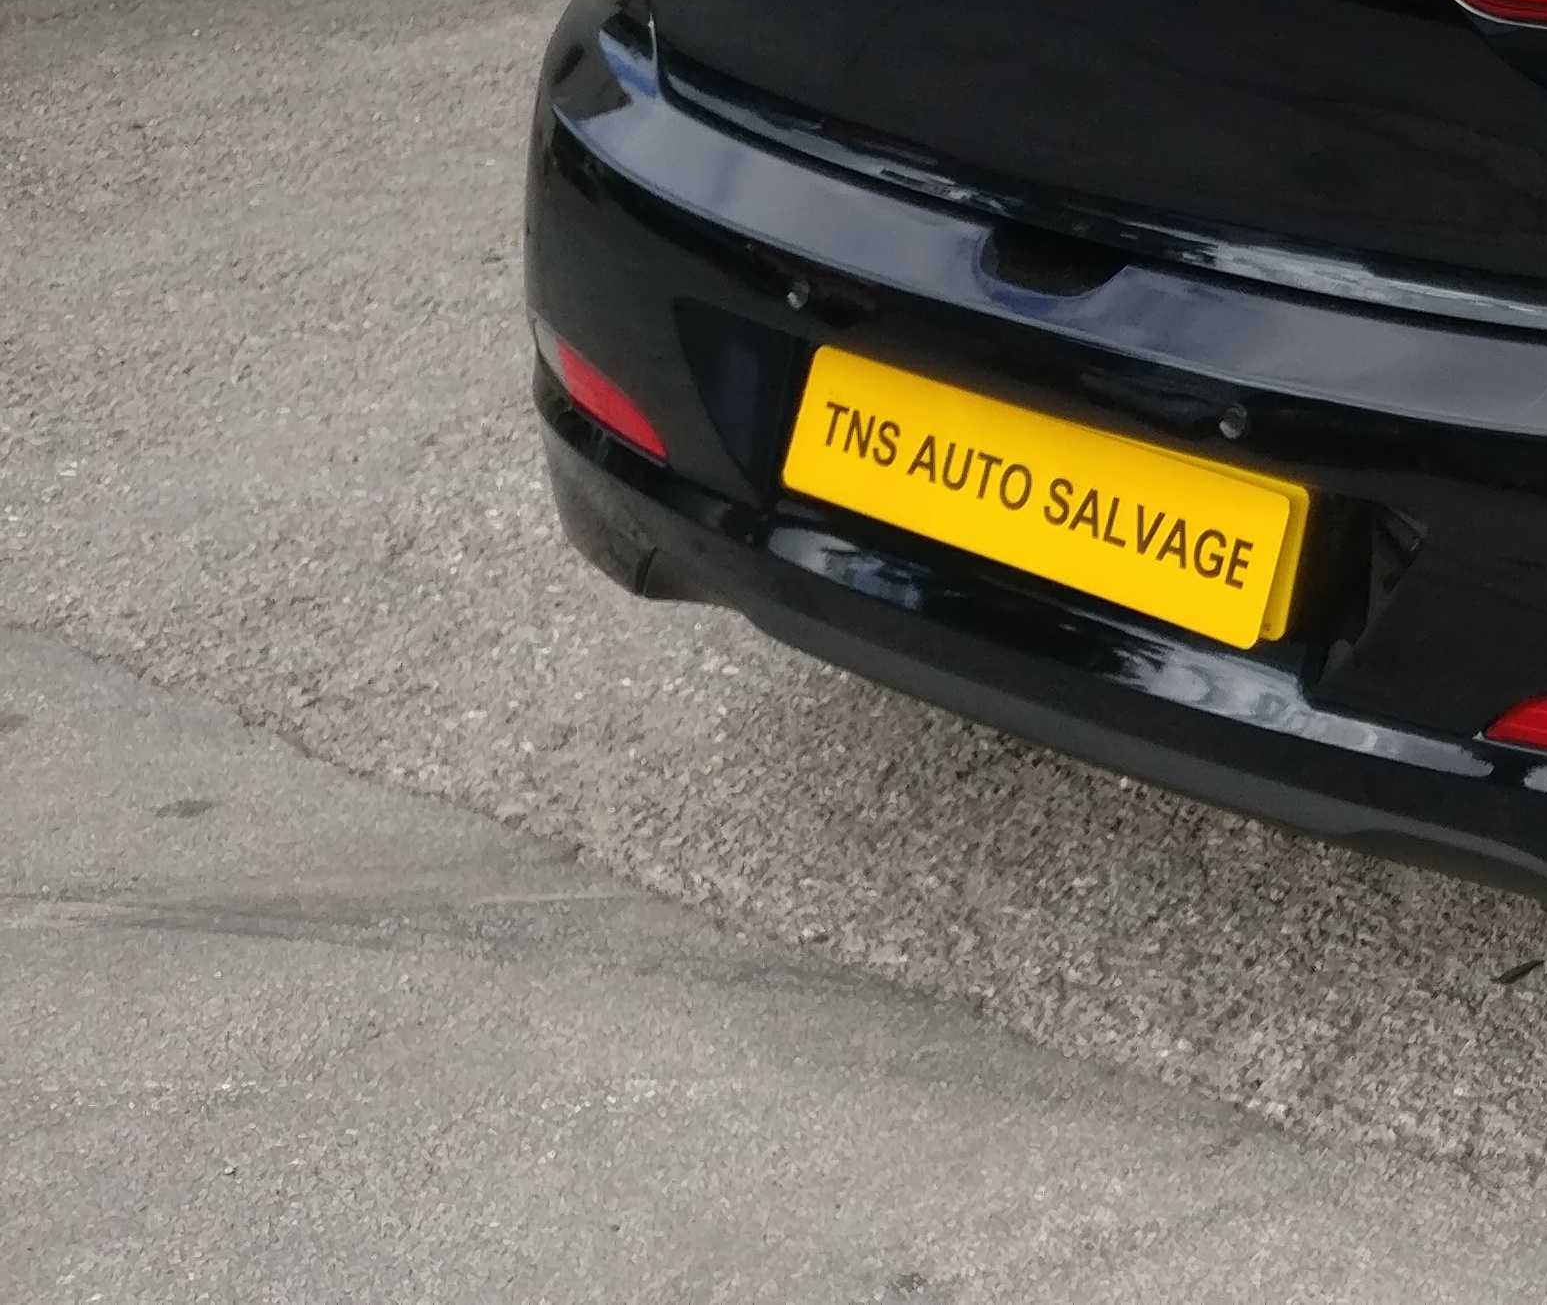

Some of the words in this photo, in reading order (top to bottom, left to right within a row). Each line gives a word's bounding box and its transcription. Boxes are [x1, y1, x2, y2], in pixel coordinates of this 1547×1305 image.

[825, 401, 901, 467] TNS
[907, 435, 1033, 512] AUTO
[1043, 477, 1255, 591] SALVAGE
